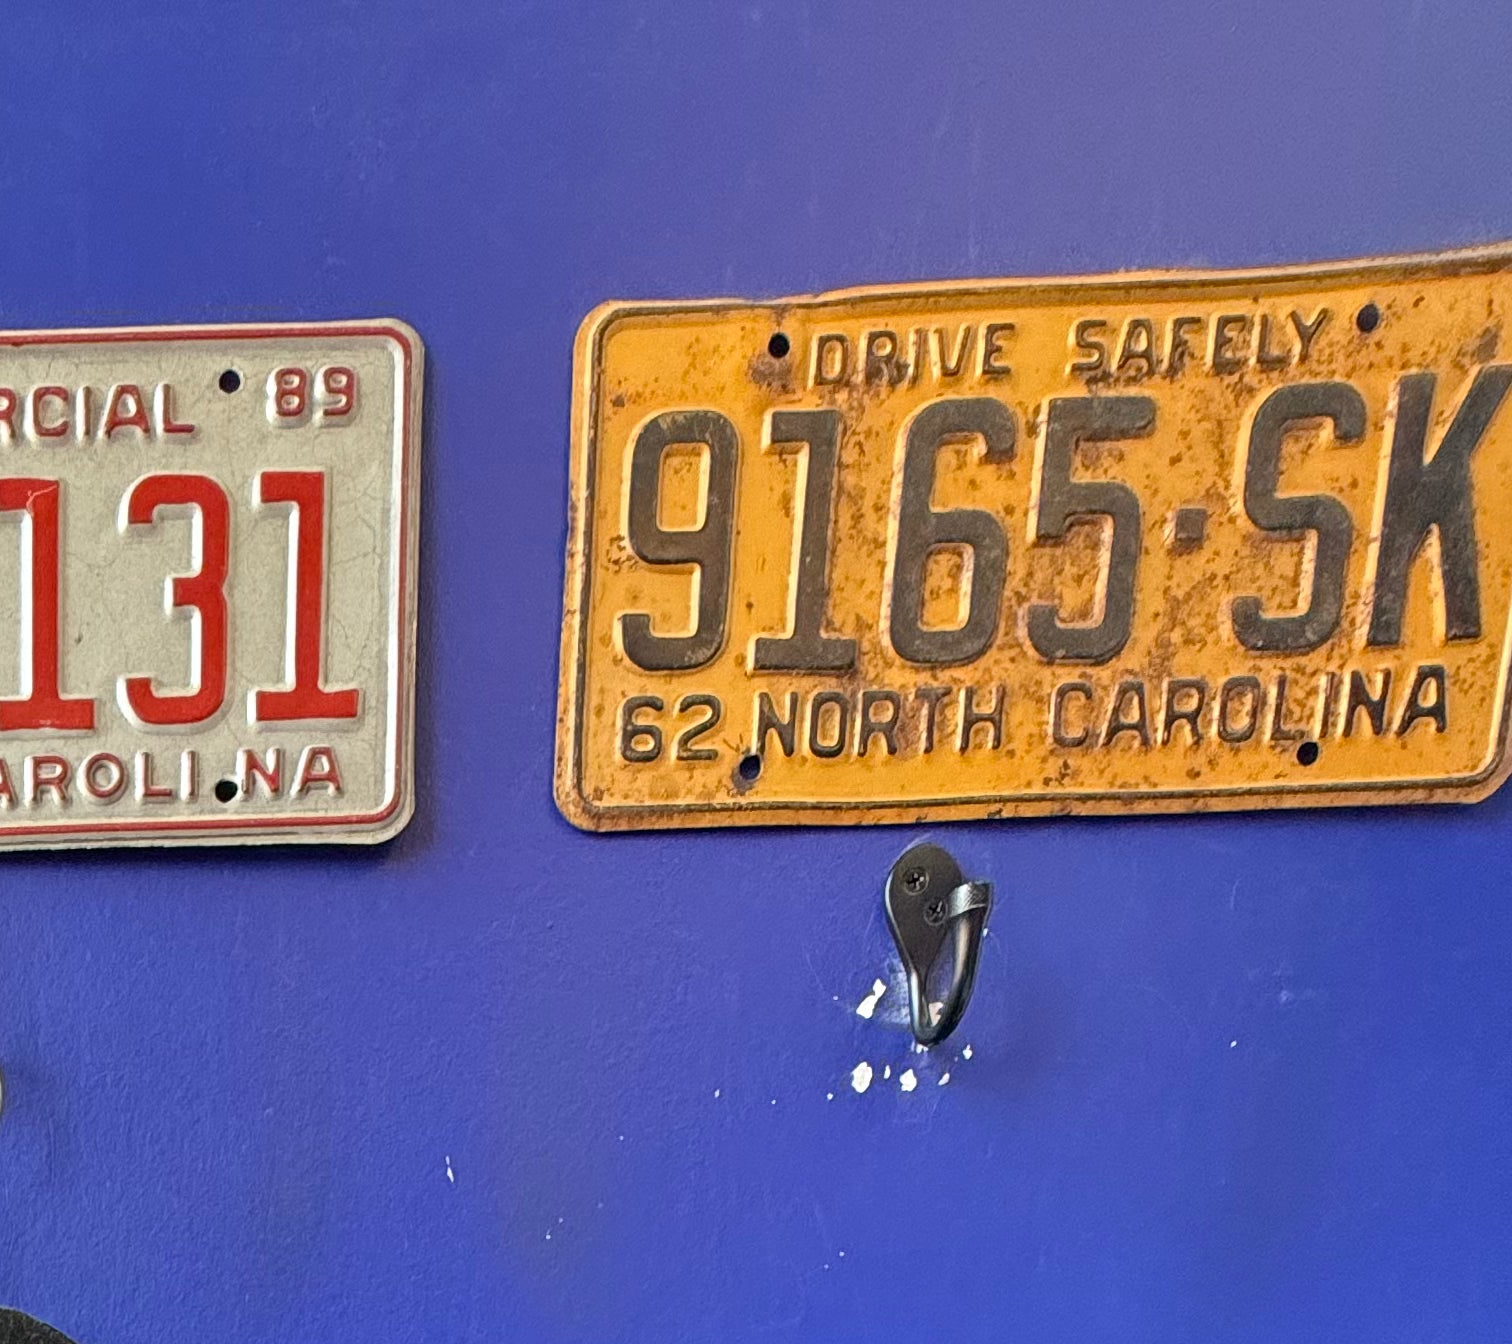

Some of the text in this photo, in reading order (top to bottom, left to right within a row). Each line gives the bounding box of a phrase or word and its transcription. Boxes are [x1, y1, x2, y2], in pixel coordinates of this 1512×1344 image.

[810, 306, 1330, 389] DRIVE SAFELY
[268, 366, 358, 420] 89
[618, 664, 1449, 763] 62 NORTH CAROLINA
